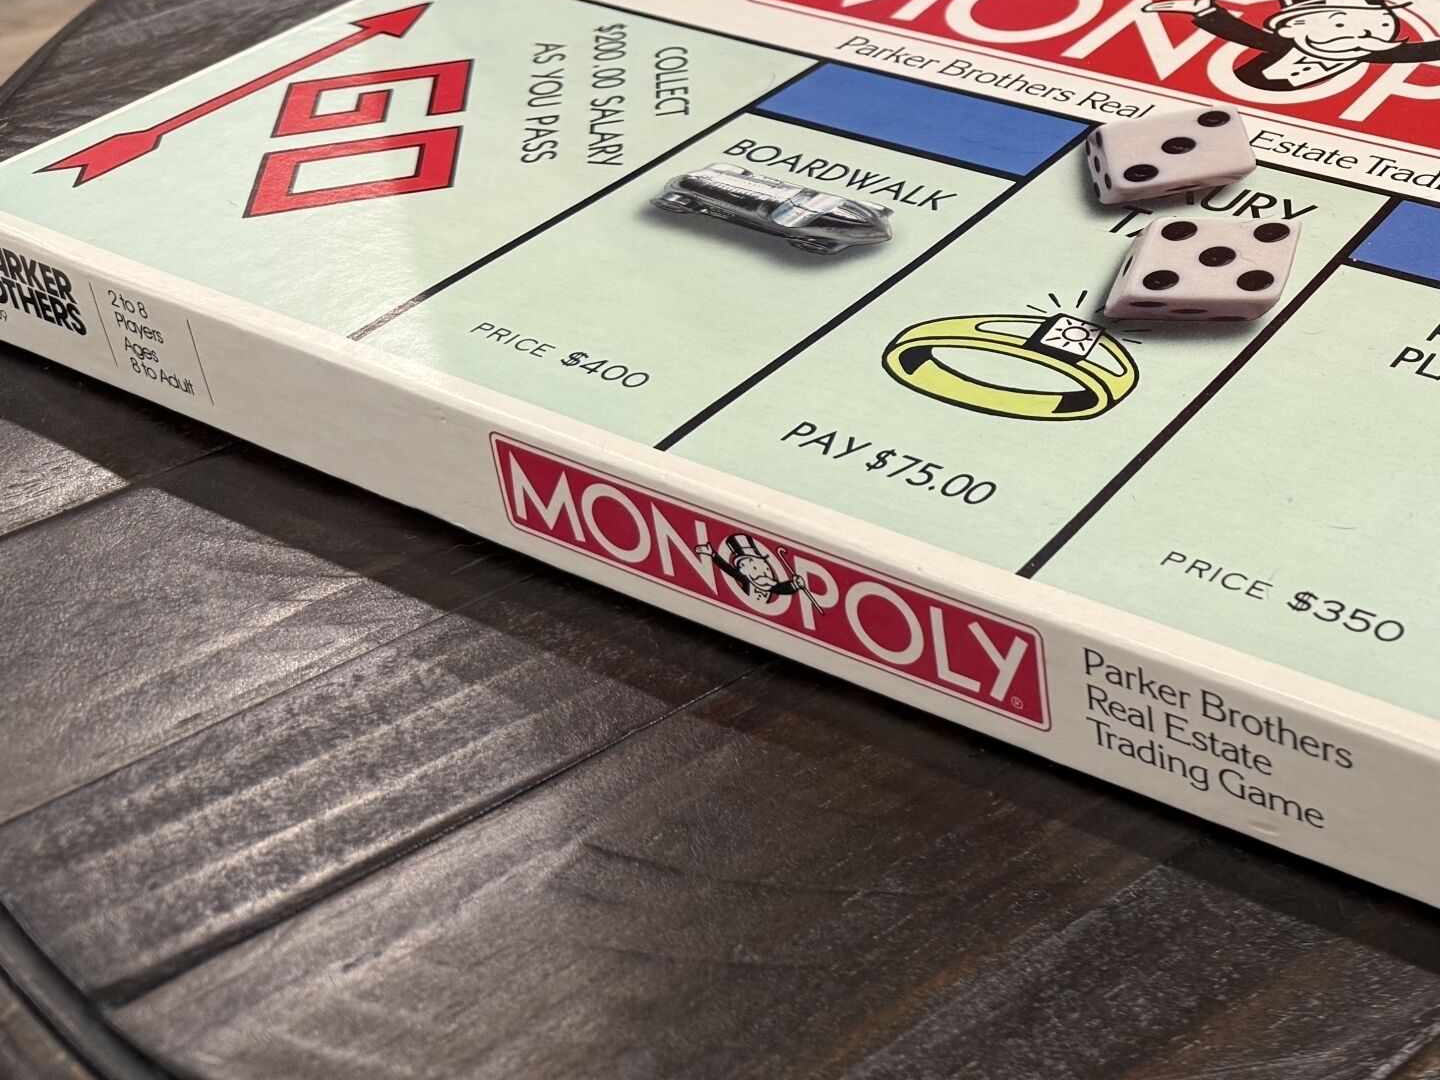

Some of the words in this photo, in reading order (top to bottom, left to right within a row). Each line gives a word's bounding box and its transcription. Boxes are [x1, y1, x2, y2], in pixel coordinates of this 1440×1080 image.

[533, 42, 567, 62] AS
[592, 22, 627, 88] $200.00
[654, 46, 687, 118] COLLECT
[529, 65, 564, 113] YOU
[836, 35, 940, 73] Parker
[940, 59, 1076, 106] Brothers
[1079, 90, 1156, 121] Real
[1248, 129, 1359, 171] Estate
[243, 59, 474, 219] GO
[520, 114, 559, 165] PASS
[586, 94, 626, 166] SALARY
[722, 138, 957, 211] BOARDWALK
[1186, 184, 1318, 220] URY
[107, 289, 120, 308] 2
[120, 294, 135, 314] to
[137, 301, 148, 319] 8
[114, 311, 164, 344] Players
[124, 337, 159, 363] Ages
[130, 357, 141, 374] 8
[142, 363, 157, 381] to
[160, 370, 195, 396] Adult
[469, 322, 557, 358] PRICE
[561, 350, 650, 390] $400
[780, 421, 872, 460] PAY
[867, 449, 997, 505] $75.00
[508, 451, 1028, 701] MONOPOLY
[1160, 550, 1272, 600] PRICE
[1287, 589, 1406, 644] $350
[1082, 647, 1191, 709] Parker
[1200, 690, 1354, 769] Brothers
[1085, 684, 1174, 742] Real
[1172, 719, 1273, 775] Estate
[1090, 717, 1210, 793] Trading
[1218, 769, 1327, 830] Game
